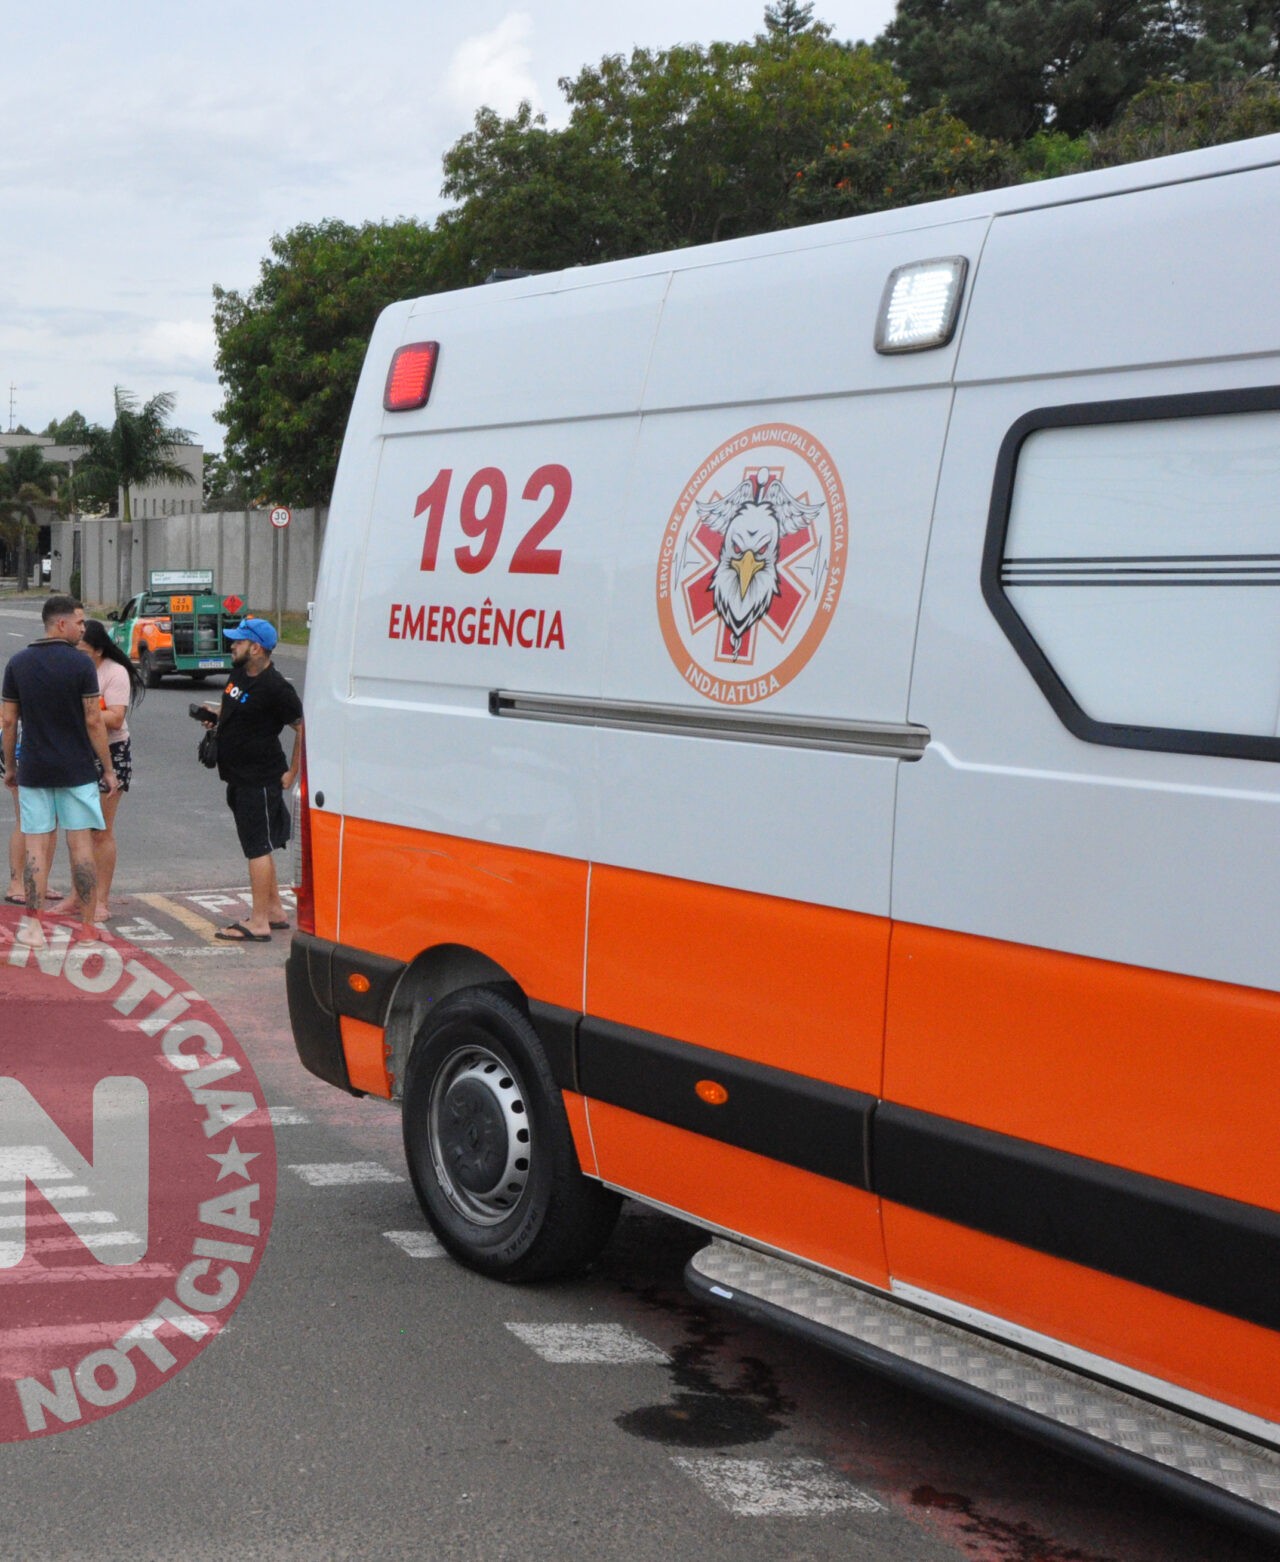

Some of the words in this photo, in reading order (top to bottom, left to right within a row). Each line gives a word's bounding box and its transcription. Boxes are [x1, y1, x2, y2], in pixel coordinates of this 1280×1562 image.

[751, 429, 808, 452] MUNICIPAL
[806, 446, 821, 463] DE
[676, 436, 749, 509] ATENDIMENTO
[274, 511, 287, 520] 30
[413, 464, 572, 575] 192
[670, 511, 684, 532] DE
[818, 460, 845, 552] EMERGÊNCIA
[659, 547, 675, 598] SERVIÇO
[822, 566, 841, 612] SAME
[388, 596, 565, 650] EMERGÊNCIA
[685, 662, 780, 702] INDAIATUBA
